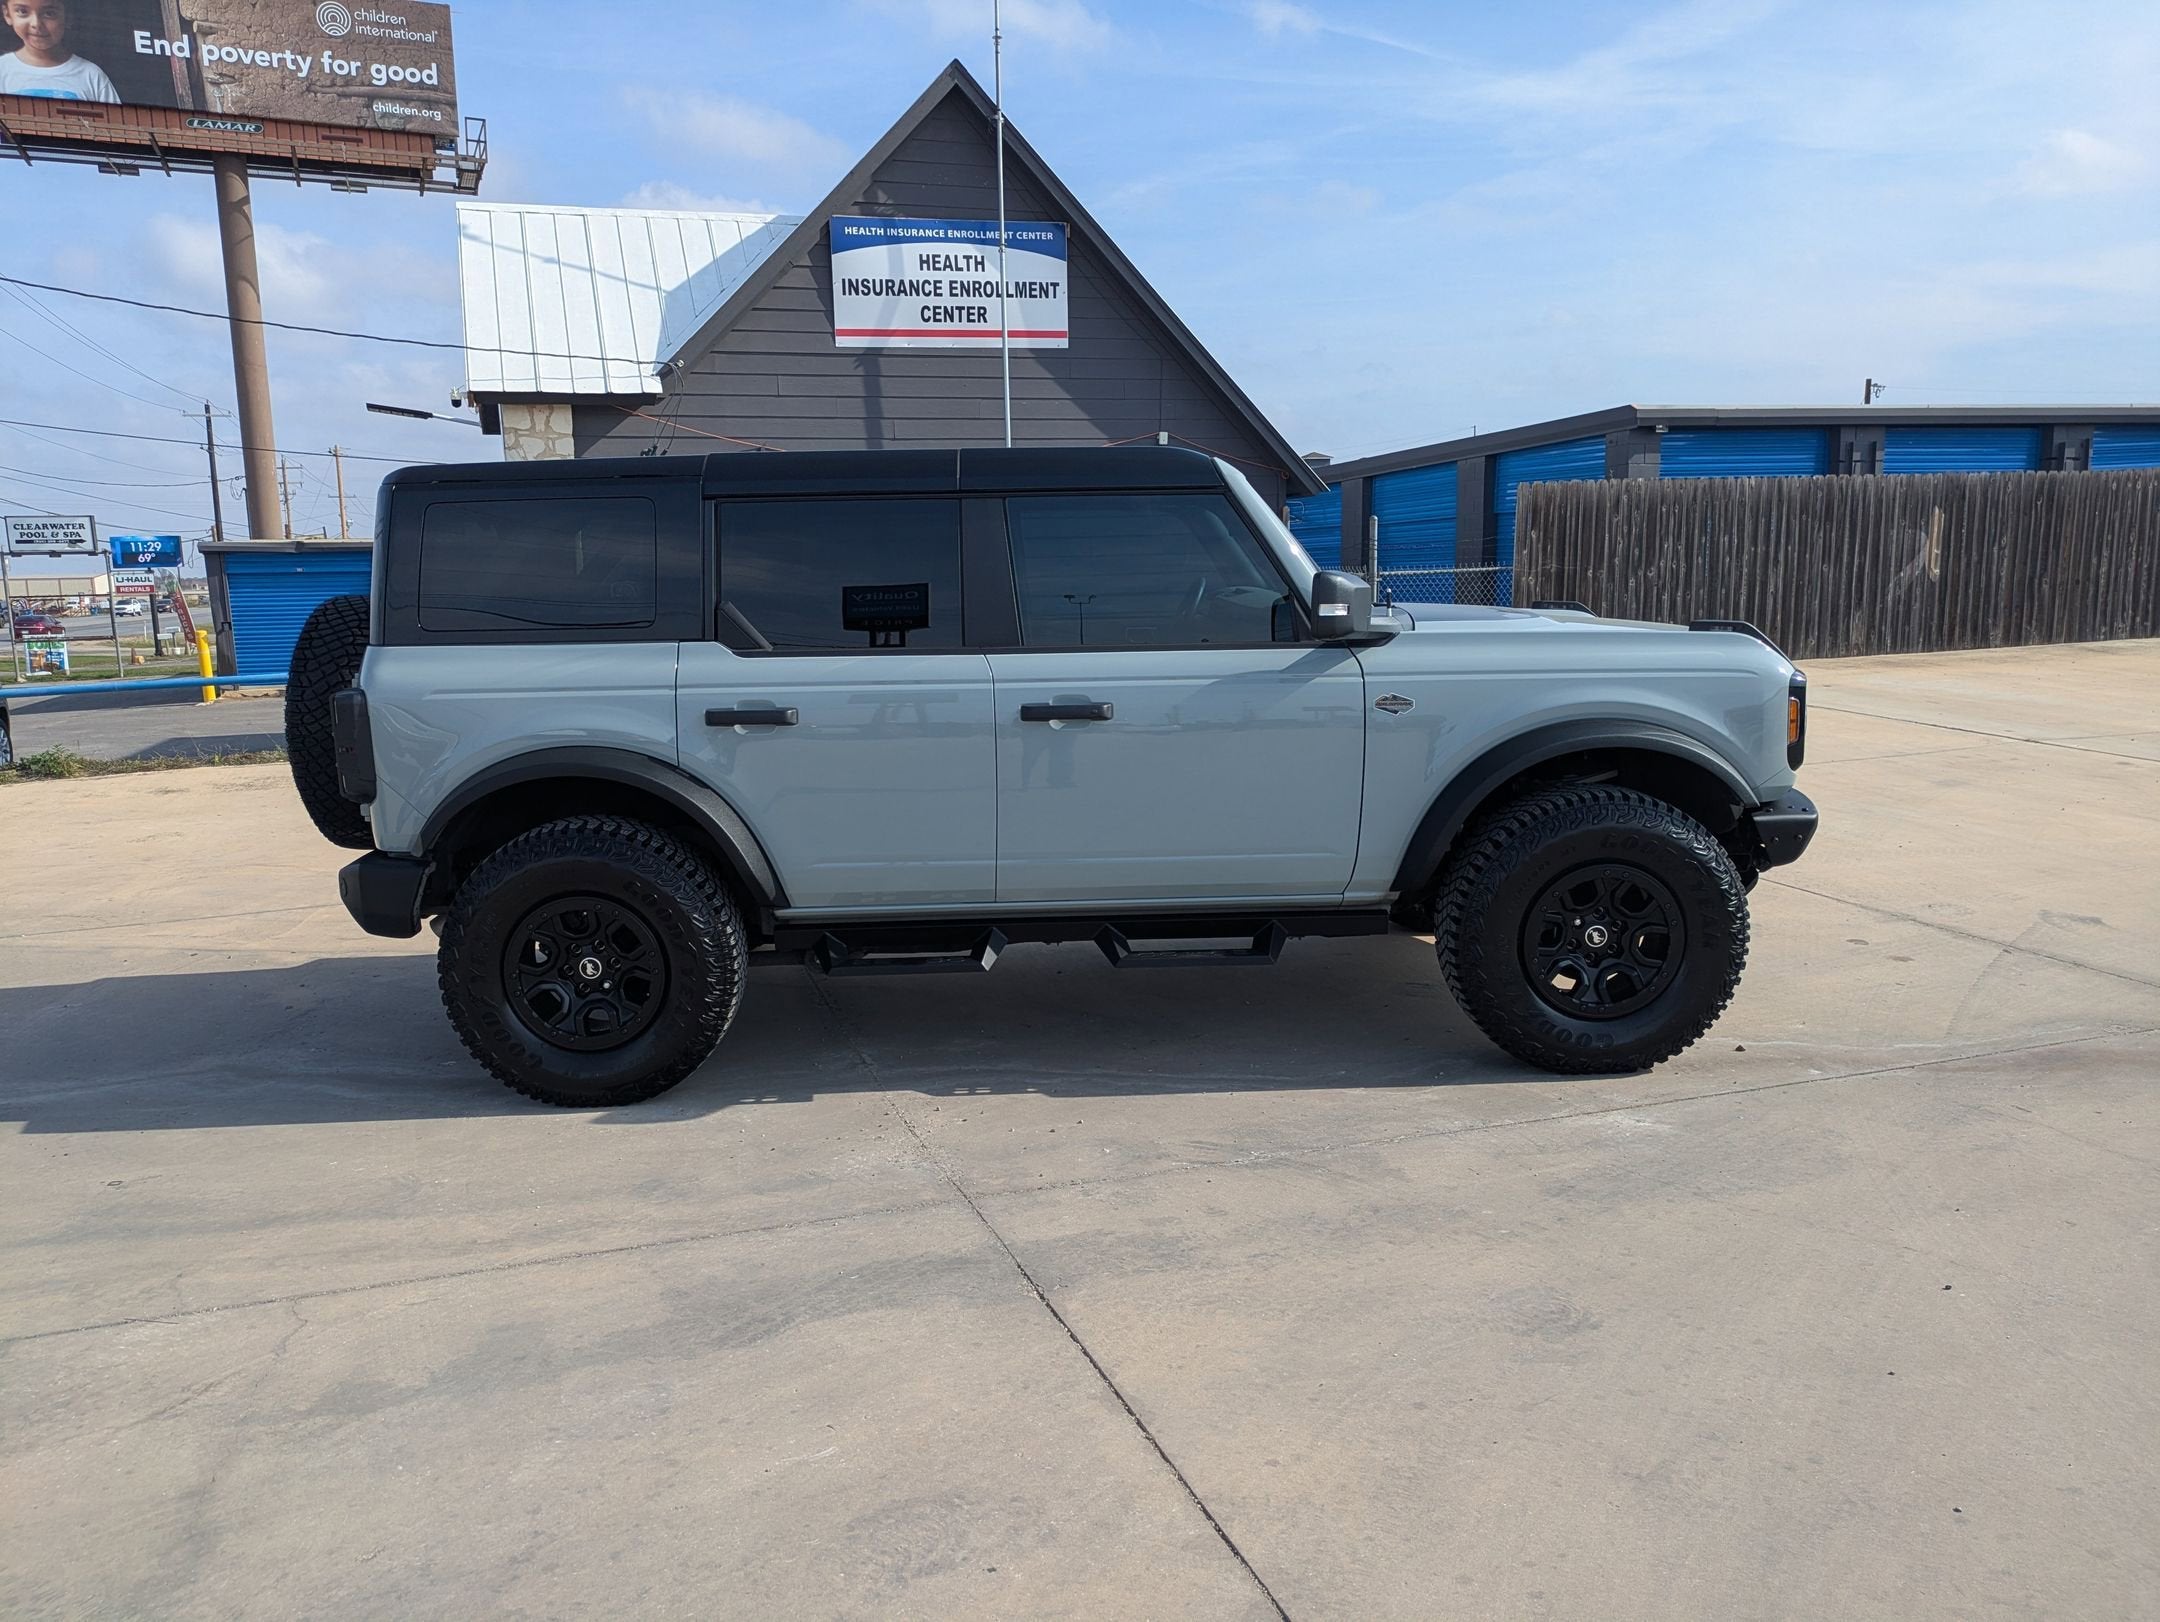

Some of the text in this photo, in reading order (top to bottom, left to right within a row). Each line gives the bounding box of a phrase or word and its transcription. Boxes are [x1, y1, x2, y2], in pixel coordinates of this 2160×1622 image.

[354, 8, 406, 25] children
[134, 30, 438, 86] End poverty for good
[372, 102, 442, 121] children.org
[193, 119, 256, 132] LAMAR
[844, 226, 884, 237] HEALTH
[887, 228, 945, 238] INSURANCE
[1016, 231, 1054, 241] CENTER
[919, 253, 986, 272] HEALTH
[841, 278, 1060, 299] INSURANCE ENROLLMENT
[920, 305, 988, 324] CENTER
[13, 522, 86, 531] CLEARWATER
[19, 531, 48, 539] POOL
[50, 531, 60, 539] &
[130, 541, 162, 552] 11:29
